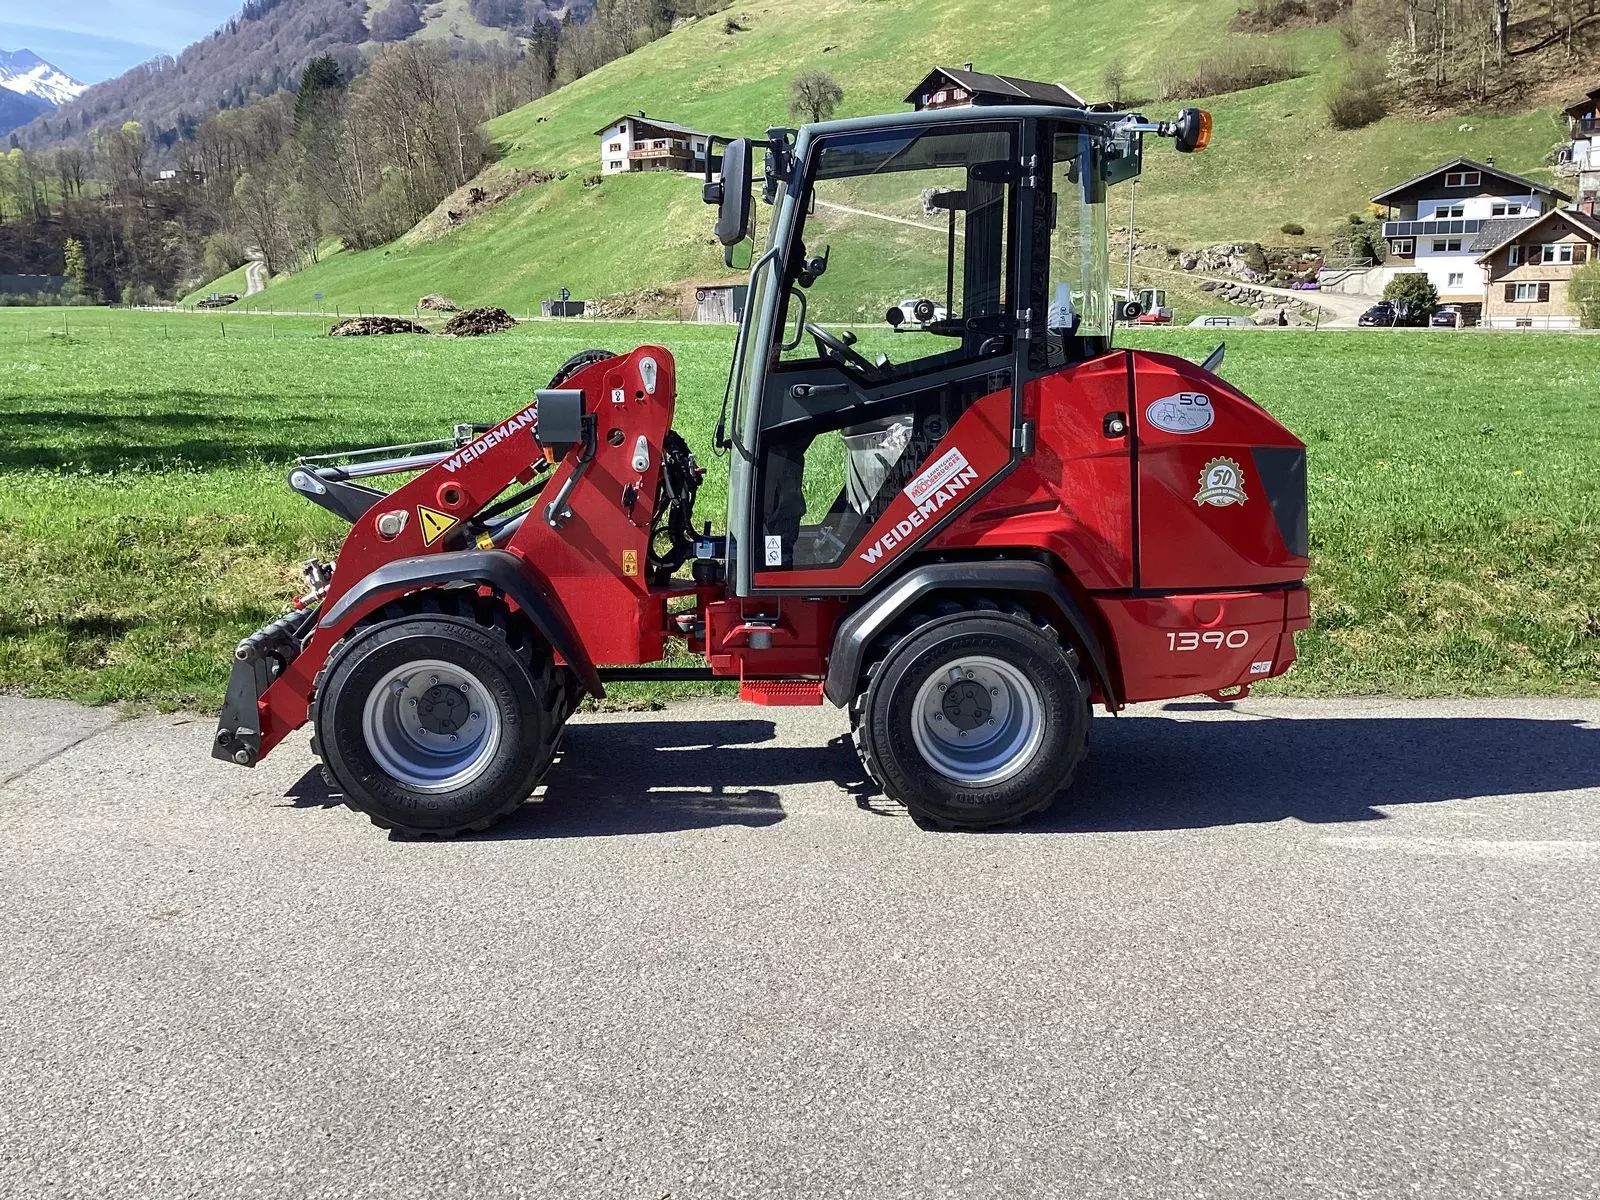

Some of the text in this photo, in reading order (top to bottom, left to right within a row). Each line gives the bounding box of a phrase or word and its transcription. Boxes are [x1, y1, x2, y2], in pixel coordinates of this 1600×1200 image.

[1179, 394, 1209, 406] 50
[1212, 469, 1233, 486] 50
[859, 465, 979, 564] WEIDEMANN
[1166, 629, 1249, 652] 1390
